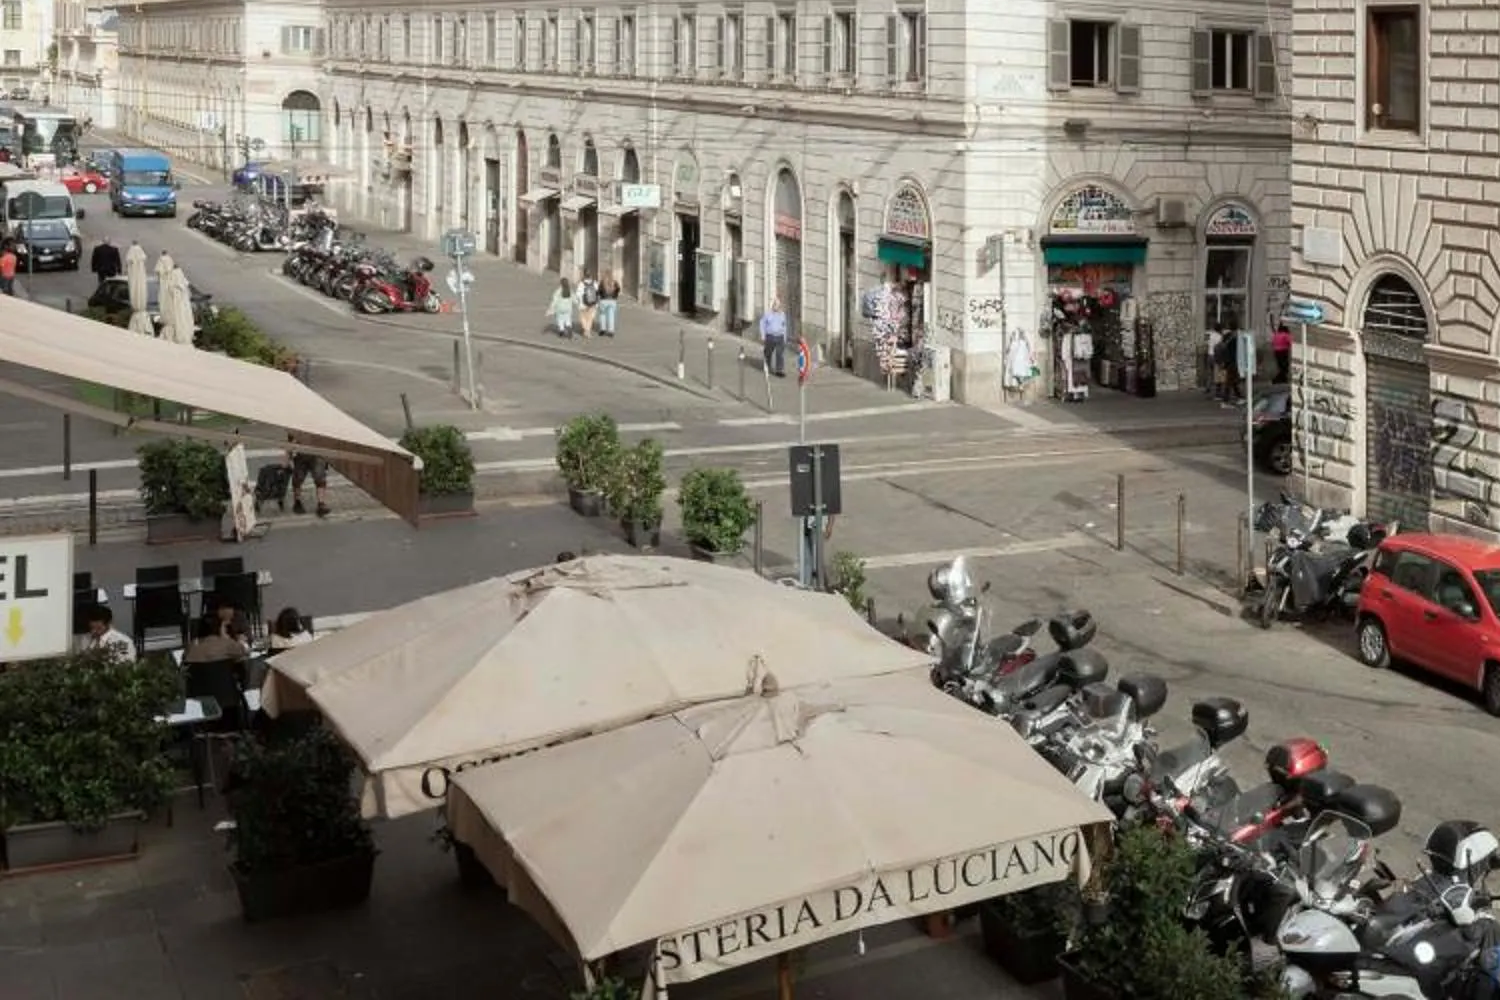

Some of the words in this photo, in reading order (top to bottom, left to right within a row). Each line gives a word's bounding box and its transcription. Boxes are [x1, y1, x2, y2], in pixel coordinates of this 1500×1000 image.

[0, 553, 48, 600] L
[832, 876, 897, 923] DA
[907, 830, 1079, 903] LUCIANO
